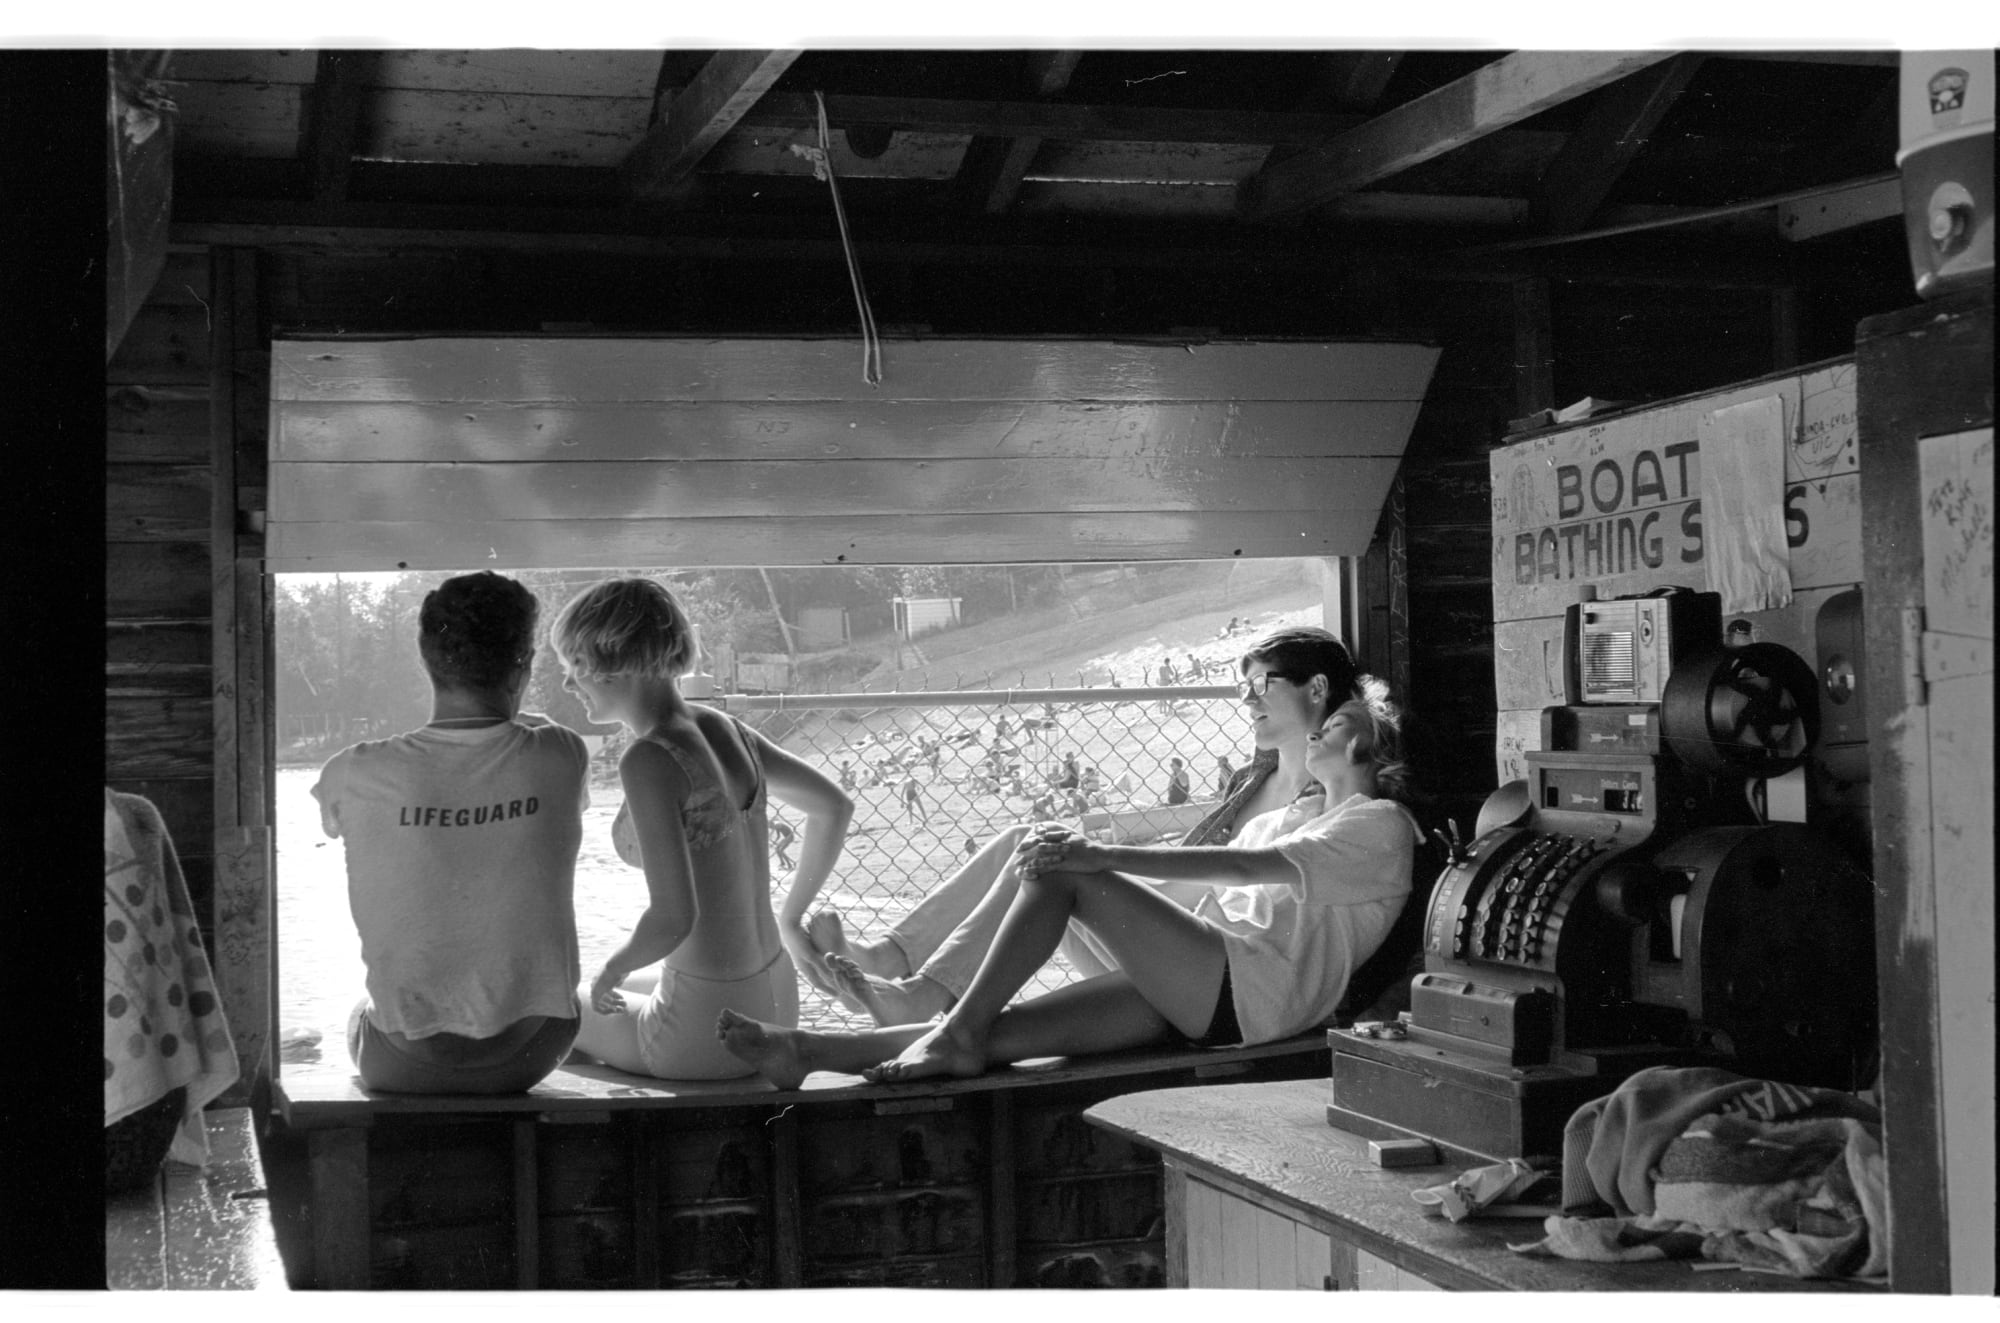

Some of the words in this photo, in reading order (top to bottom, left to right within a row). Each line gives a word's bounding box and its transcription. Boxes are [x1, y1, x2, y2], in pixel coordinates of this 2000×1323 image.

[1557, 441, 1700, 520] BOAT
[1515, 511, 1663, 585] BATHING
[400, 797, 539, 827] LIFEGUARD
